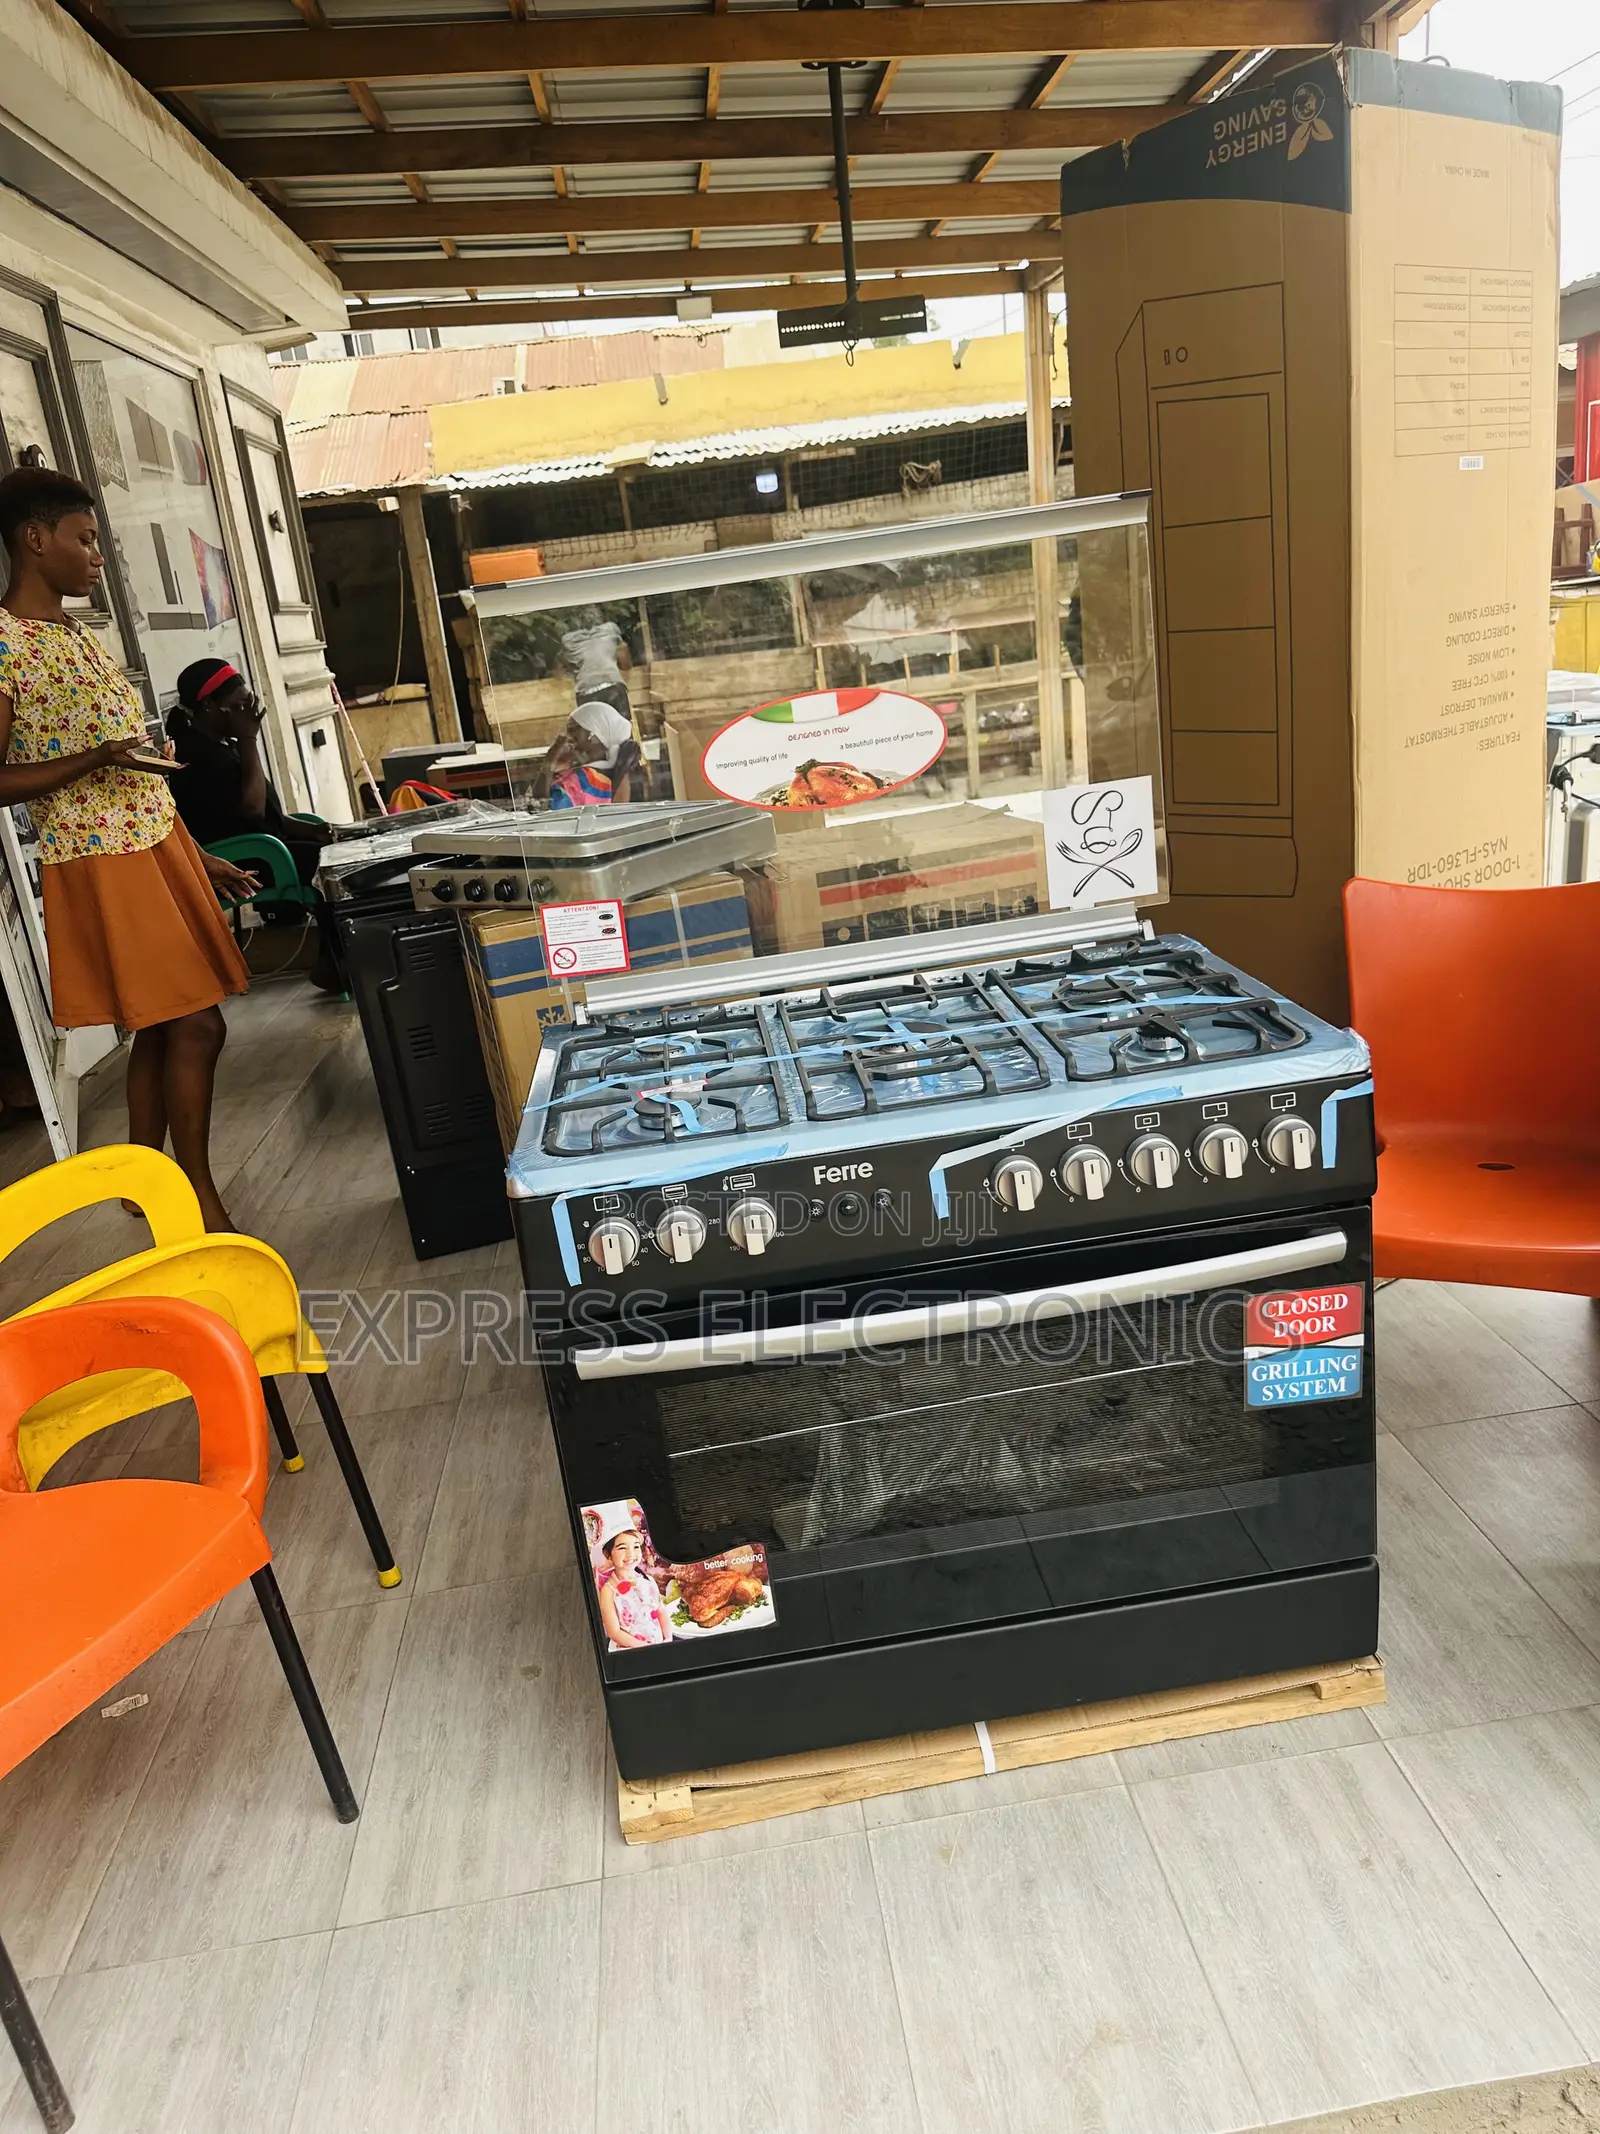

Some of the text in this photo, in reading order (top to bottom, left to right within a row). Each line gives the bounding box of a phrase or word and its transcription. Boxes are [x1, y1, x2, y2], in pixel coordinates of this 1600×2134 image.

[1214, 99, 1287, 140] SAVING
[1205, 122, 1288, 169] ENERGY
[1444, 164, 1464, 176] CHINA
[1472, 168, 1490, 179] MADE
[1448, 603, 1510, 624] ENERGY SAVING
[1446, 625, 1510, 647] DIRECT COOLING
[1468, 647, 1509, 665] LOW NOISE
[1452, 677, 1472, 691] FREE
[1474, 674, 1488, 686] CFC
[1440, 691, 1508, 716] MANUAL DEFROST
[788, 730, 822, 741] DESIGNED
[875, 736, 892, 746] piece
[900, 733, 914, 741] your
[916, 729, 933, 737] home
[1404, 712, 1508, 748] ADJUSTABLE THERMOSTAT
[1476, 730, 1520, 751] FEATURES:
[748, 756, 769, 766] quality
[1407, 836, 1508, 884] NAS-FL360-1DR
[1475, 855, 1520, 884] 1-DOOR
[563, 905, 599, 913] ATTENTION!
[813, 1162, 874, 1186] Ferre
[1262, 1294, 1348, 1318] CLOSED
[1273, 1316, 1336, 1338] DOOR
[1252, 1354, 1357, 1382] GRILLING
[1262, 1376, 1347, 1401] SYSTEM
[704, 1554, 763, 1570] better cooking
